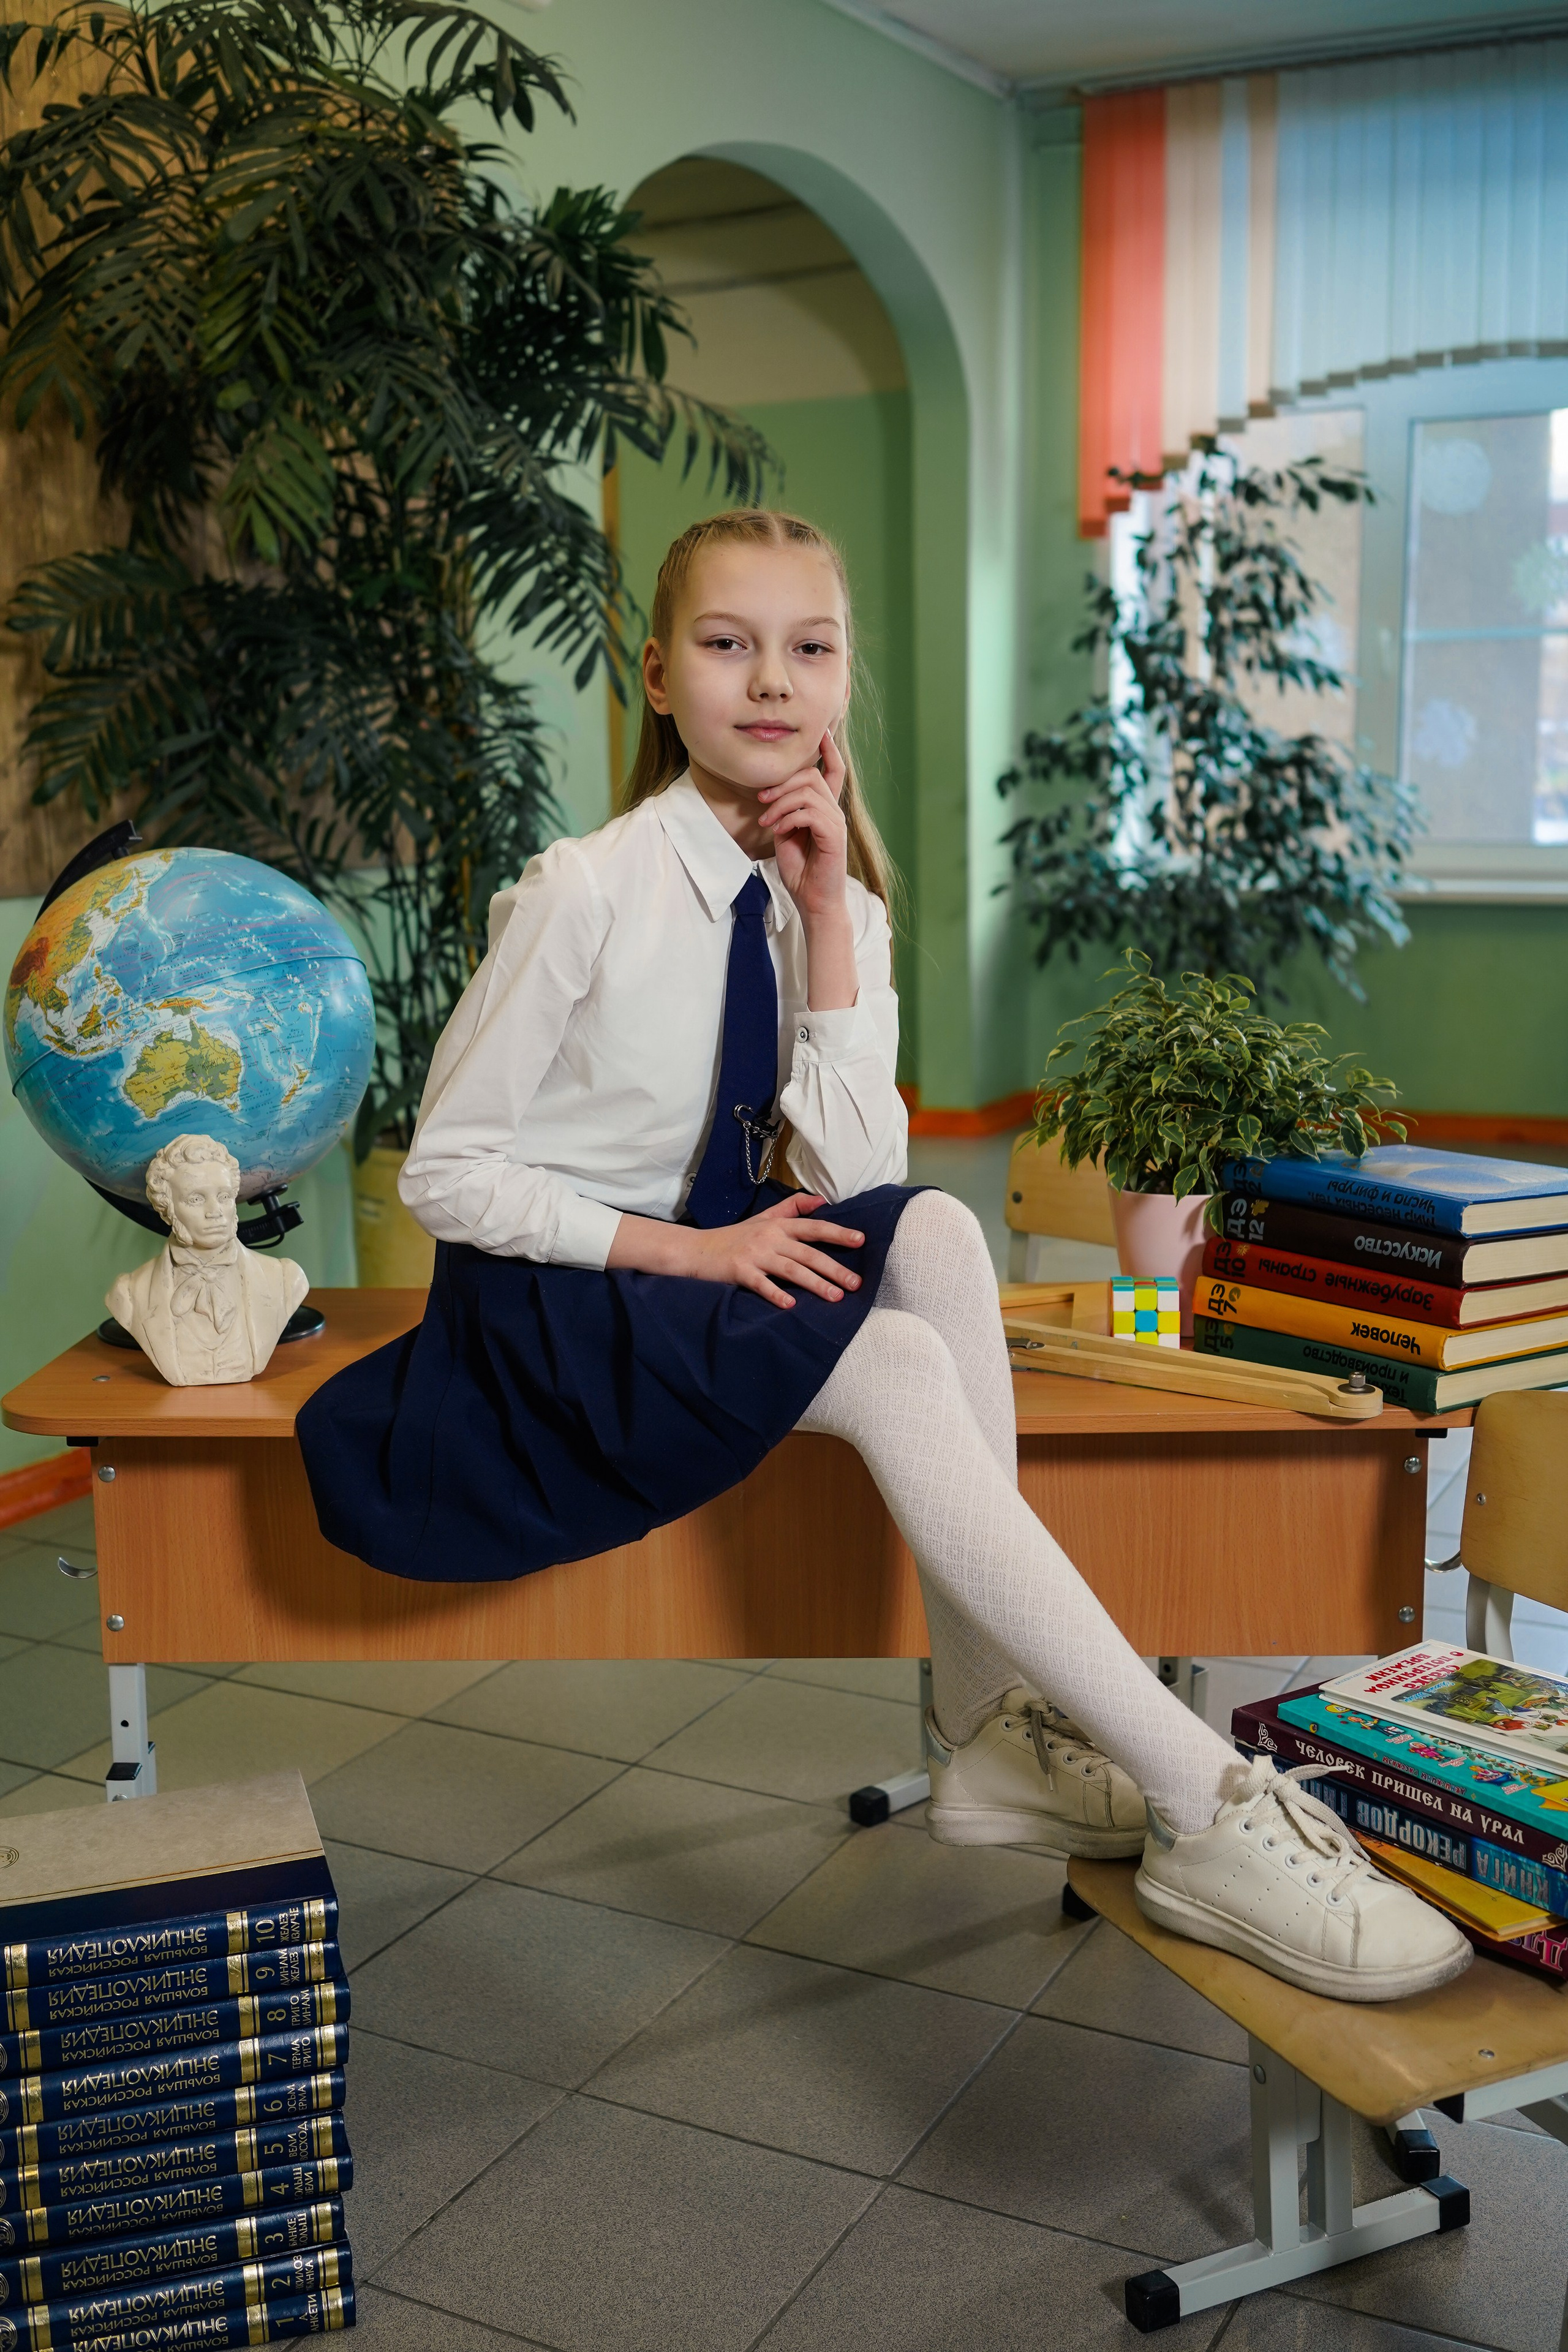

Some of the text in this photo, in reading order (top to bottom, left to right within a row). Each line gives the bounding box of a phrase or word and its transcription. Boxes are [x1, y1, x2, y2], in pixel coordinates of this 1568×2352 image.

[1327, 1180, 1436, 1215] Числа и фигуры
[1335, 1197, 1401, 1220] небесных
[1227, 1198, 1248, 1239] ДЭ
[1250, 1219, 1265, 1241] 12
[1213, 1241, 1232, 1275] ДЭ
[1231, 1257, 1246, 1278] 10
[1354, 1235, 1442, 1269] Искусство
[1208, 1283, 1226, 1316] ДЭ
[1258, 1258, 1434, 1311] Зарубежные страны
[1223, 1298, 1237, 1314] 7
[1204, 1318, 1220, 1352] ДЭ
[1220, 1335, 1234, 1351] 5
[1350, 1321, 1421, 1355] Человек
[1303, 1345, 1409, 1384] и производство
[1363, 1656, 1455, 1694] ПОТЕРЯННОМ
[1365, 1653, 1431, 1681] ВРЕМЕНИ
[1382, 1756, 1419, 1776] РАССКАЗЫ
[1295, 1740, 1366, 1781] ЧЕЛОВЕК
[1371, 1770, 1443, 1812] ПРИШЕЛ
[1450, 1802, 1474, 1824] НА
[1480, 1814, 1525, 1845] УРАЛ
[1420, 1771, 1466, 1795] ДЕНИСКИНЫ
[1356, 1798, 1550, 1905] КНИГА РЕКОРДОВ
[255, 1920, 275, 1943] 10
[279, 1912, 289, 1942] ЖЕЛЕЗ
[289, 1906, 300, 1942] ИЗЛУЧЕ
[47, 1926, 207, 1965] ЭНЦИКЛОПЕДИЯ
[49, 1945, 208, 1978] БОЛЬШАЯ РОССИЙСКАЯ
[255, 1966, 275, 1980] 9
[290, 1951, 300, 1981] ЖЕЛЕЗ
[48, 1967, 207, 2007] ЭНЦИКЛОПЕДИЯ
[50, 1986, 208, 2020] БОЛЬШАЯ РОССИЙСКАЯ
[266, 2008, 287, 2021] 8
[290, 1995, 300, 2026] ГРИГО
[61, 2010, 218, 2049] ЭНЦИКЛОПЕДИЯ
[62, 2029, 219, 2062] БОЛЬШАЯ РОССИЙСКАЯ
[268, 2053, 287, 2065] 7
[291, 2038, 301, 2070] ГЕРМА
[301, 2036, 312, 2068] ГРИГО
[62, 2054, 220, 2097] ЭНЦИКЛОПЕДИЯ
[64, 2073, 221, 2111] БОЛЬШАЯ РОССИЙСКАЯ
[263, 2099, 282, 2113] 6
[287, 2084, 297, 2113] ОСЬМ
[298, 2084, 308, 2111] ЕРМА
[58, 2101, 216, 2141] ЭНЦИКЛОПЕДИЯ
[59, 2120, 216, 2155] БОЛЬШАЯ РОССИЙСКАЯ
[265, 2143, 284, 2155] 5
[288, 2132, 298, 2158] ВЕЛИ
[59, 2143, 217, 2184] ЭНЦИКЛОПЕДИЯ
[61, 2163, 217, 2198] БОЛЬШАЯ РОССИЙСКАЯ
[270, 2182, 290, 2196] 4
[304, 2171, 314, 2196] ВЕЛИ
[67, 2185, 223, 2226] ЭНЦИКЛОПЕДИЯ
[69, 2203, 223, 2238] БОЛЬШАЯ РОССИЙСКАЯ
[265, 2232, 284, 2245] 3
[287, 2217, 298, 2247] БАНКЕ
[62, 2236, 217, 2278] ЭНЦИКЛОПЕДИЯ
[63, 2253, 218, 2291] БОЛЬШАЯ РОССИЙСКАЯ
[293, 2255, 304, 2291] НКИЛОЗ
[271, 2275, 291, 2290] 2
[69, 2280, 225, 2324] ЭНЦИКЛОПЕДИЯ
[71, 2297, 225, 2337] БОЛЬШАЯ РОССИЙСКАЯ
[299, 2312, 309, 2321] А
[307, 2293, 319, 2332] АНКЕТИ
[73, 2316, 228, 2352] ЭНЦИКЛОПЕДИЯ
[275, 2317, 295, 2328] 1
[167, 2335, 229, 2352] БОЛЬШАЯ
